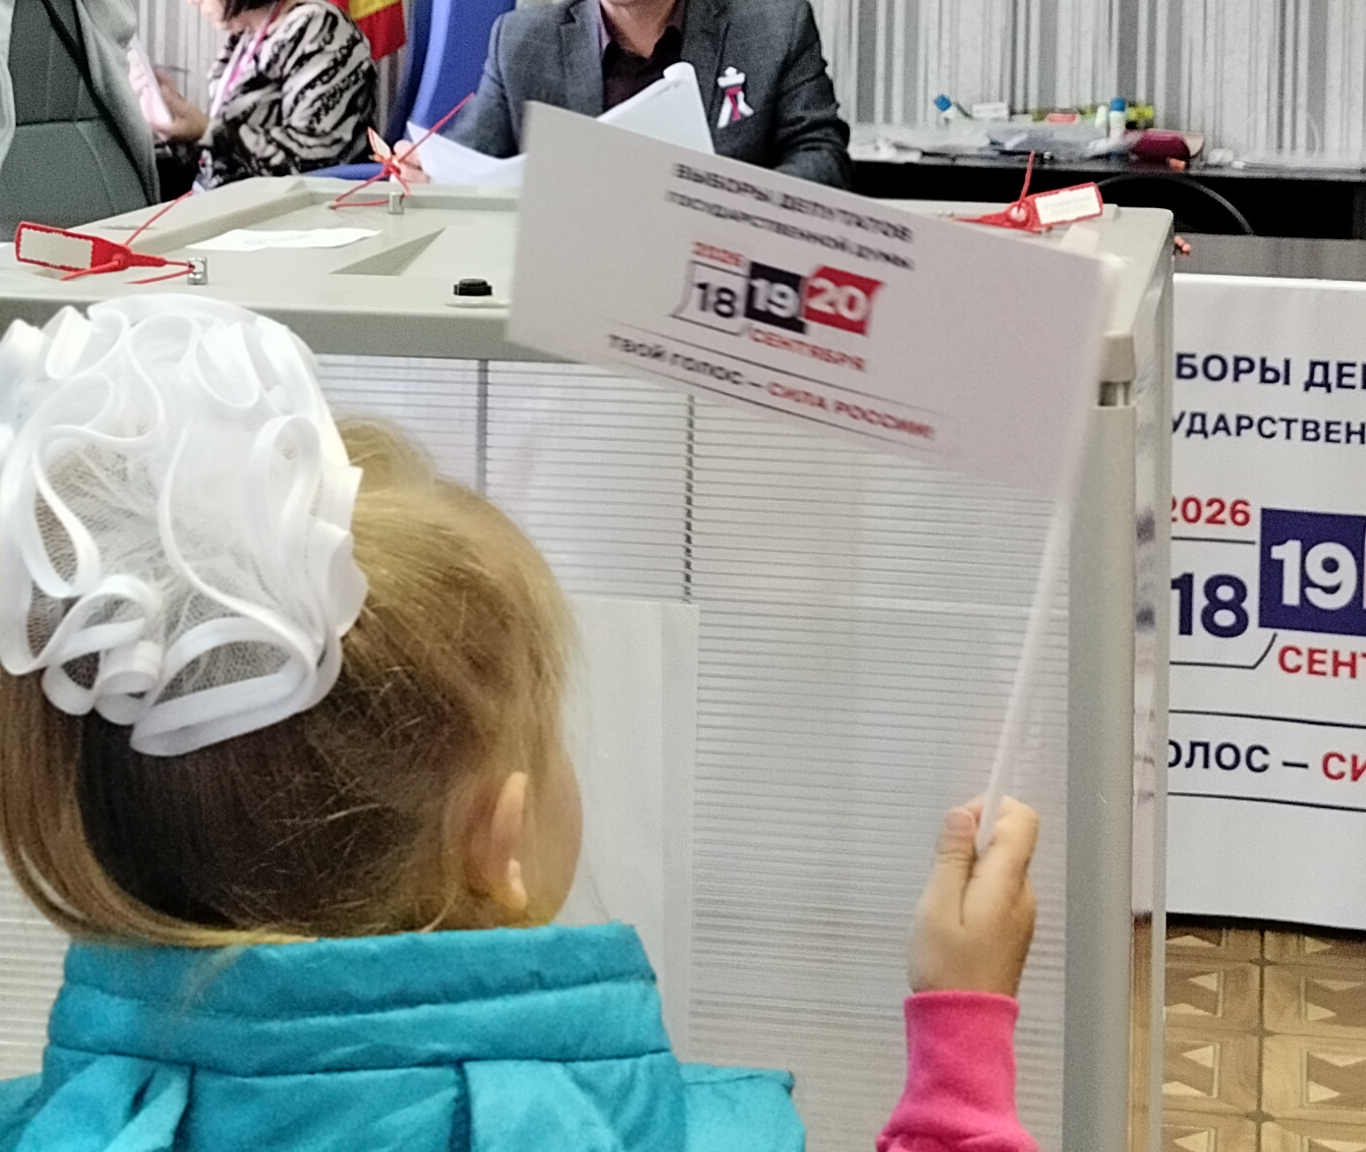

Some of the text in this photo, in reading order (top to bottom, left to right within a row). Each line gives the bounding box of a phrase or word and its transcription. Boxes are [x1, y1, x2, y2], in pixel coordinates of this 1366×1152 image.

[695, 276, 870, 322] 18 19 20
[1171, 496, 1252, 527] 026
[1170, 571, 1250, 639] 18
[1269, 539, 1359, 611] 19
